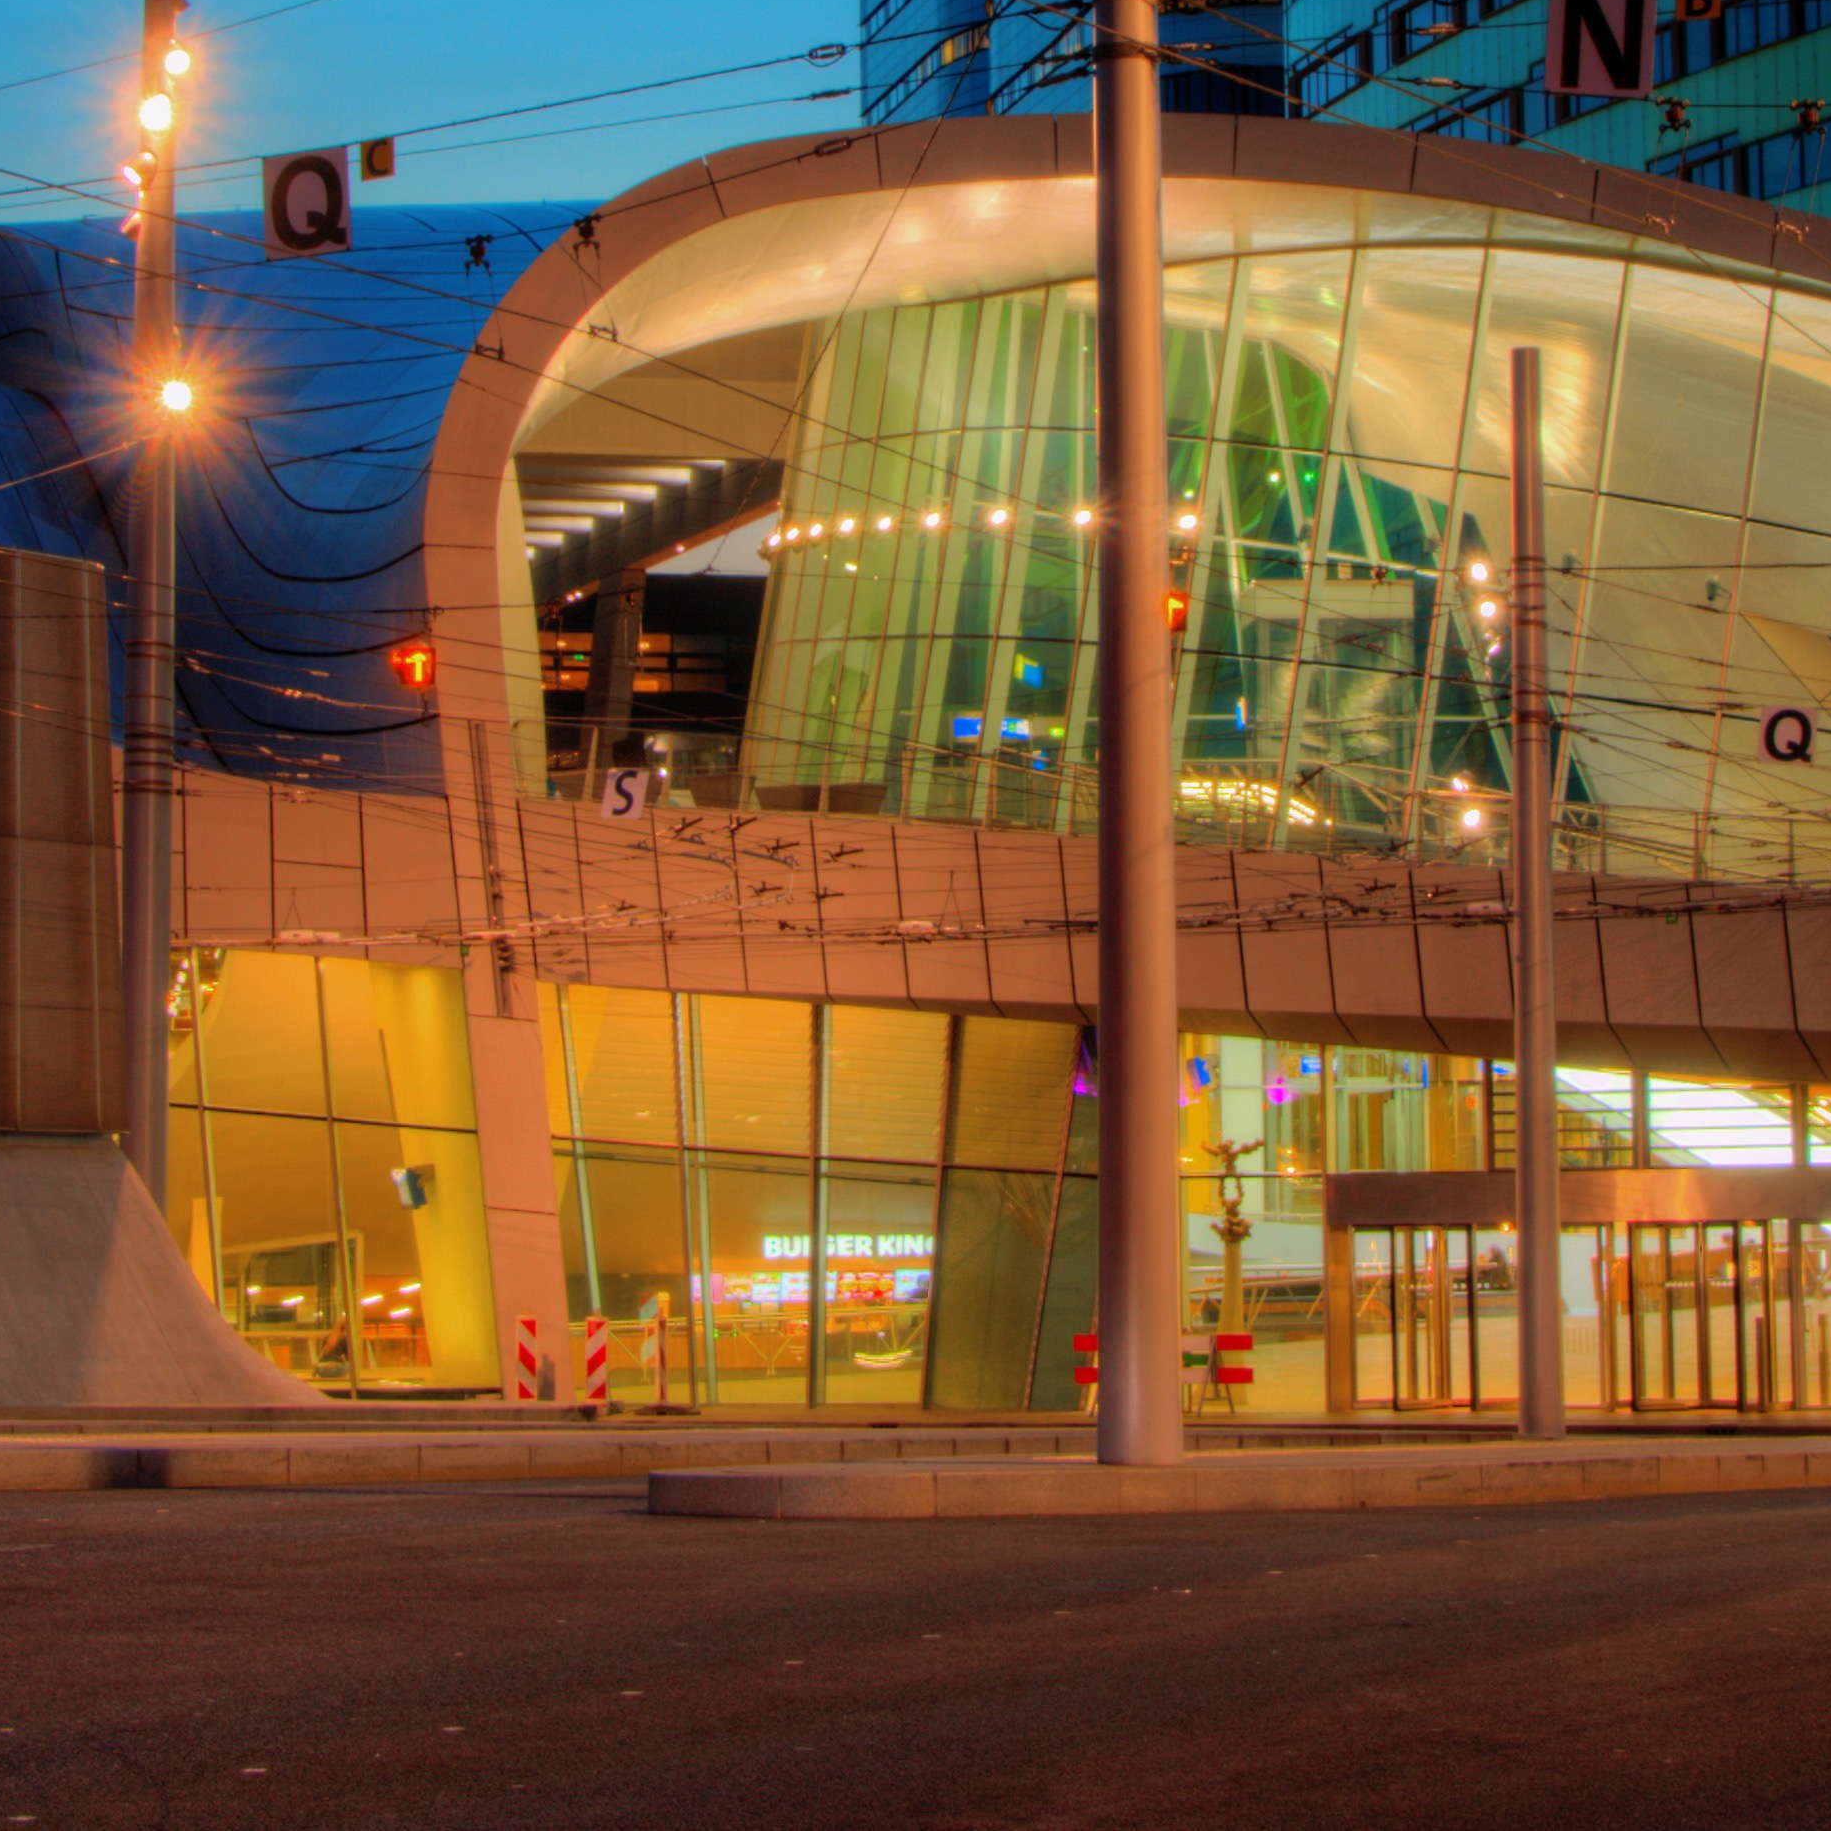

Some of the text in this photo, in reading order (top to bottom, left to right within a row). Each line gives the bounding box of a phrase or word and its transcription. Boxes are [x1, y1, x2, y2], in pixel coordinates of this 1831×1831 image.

[367, 138, 388, 176] C
[272, 155, 347, 251] Q
[1764, 709, 1812, 763] Q
[612, 770, 638, 816] S
